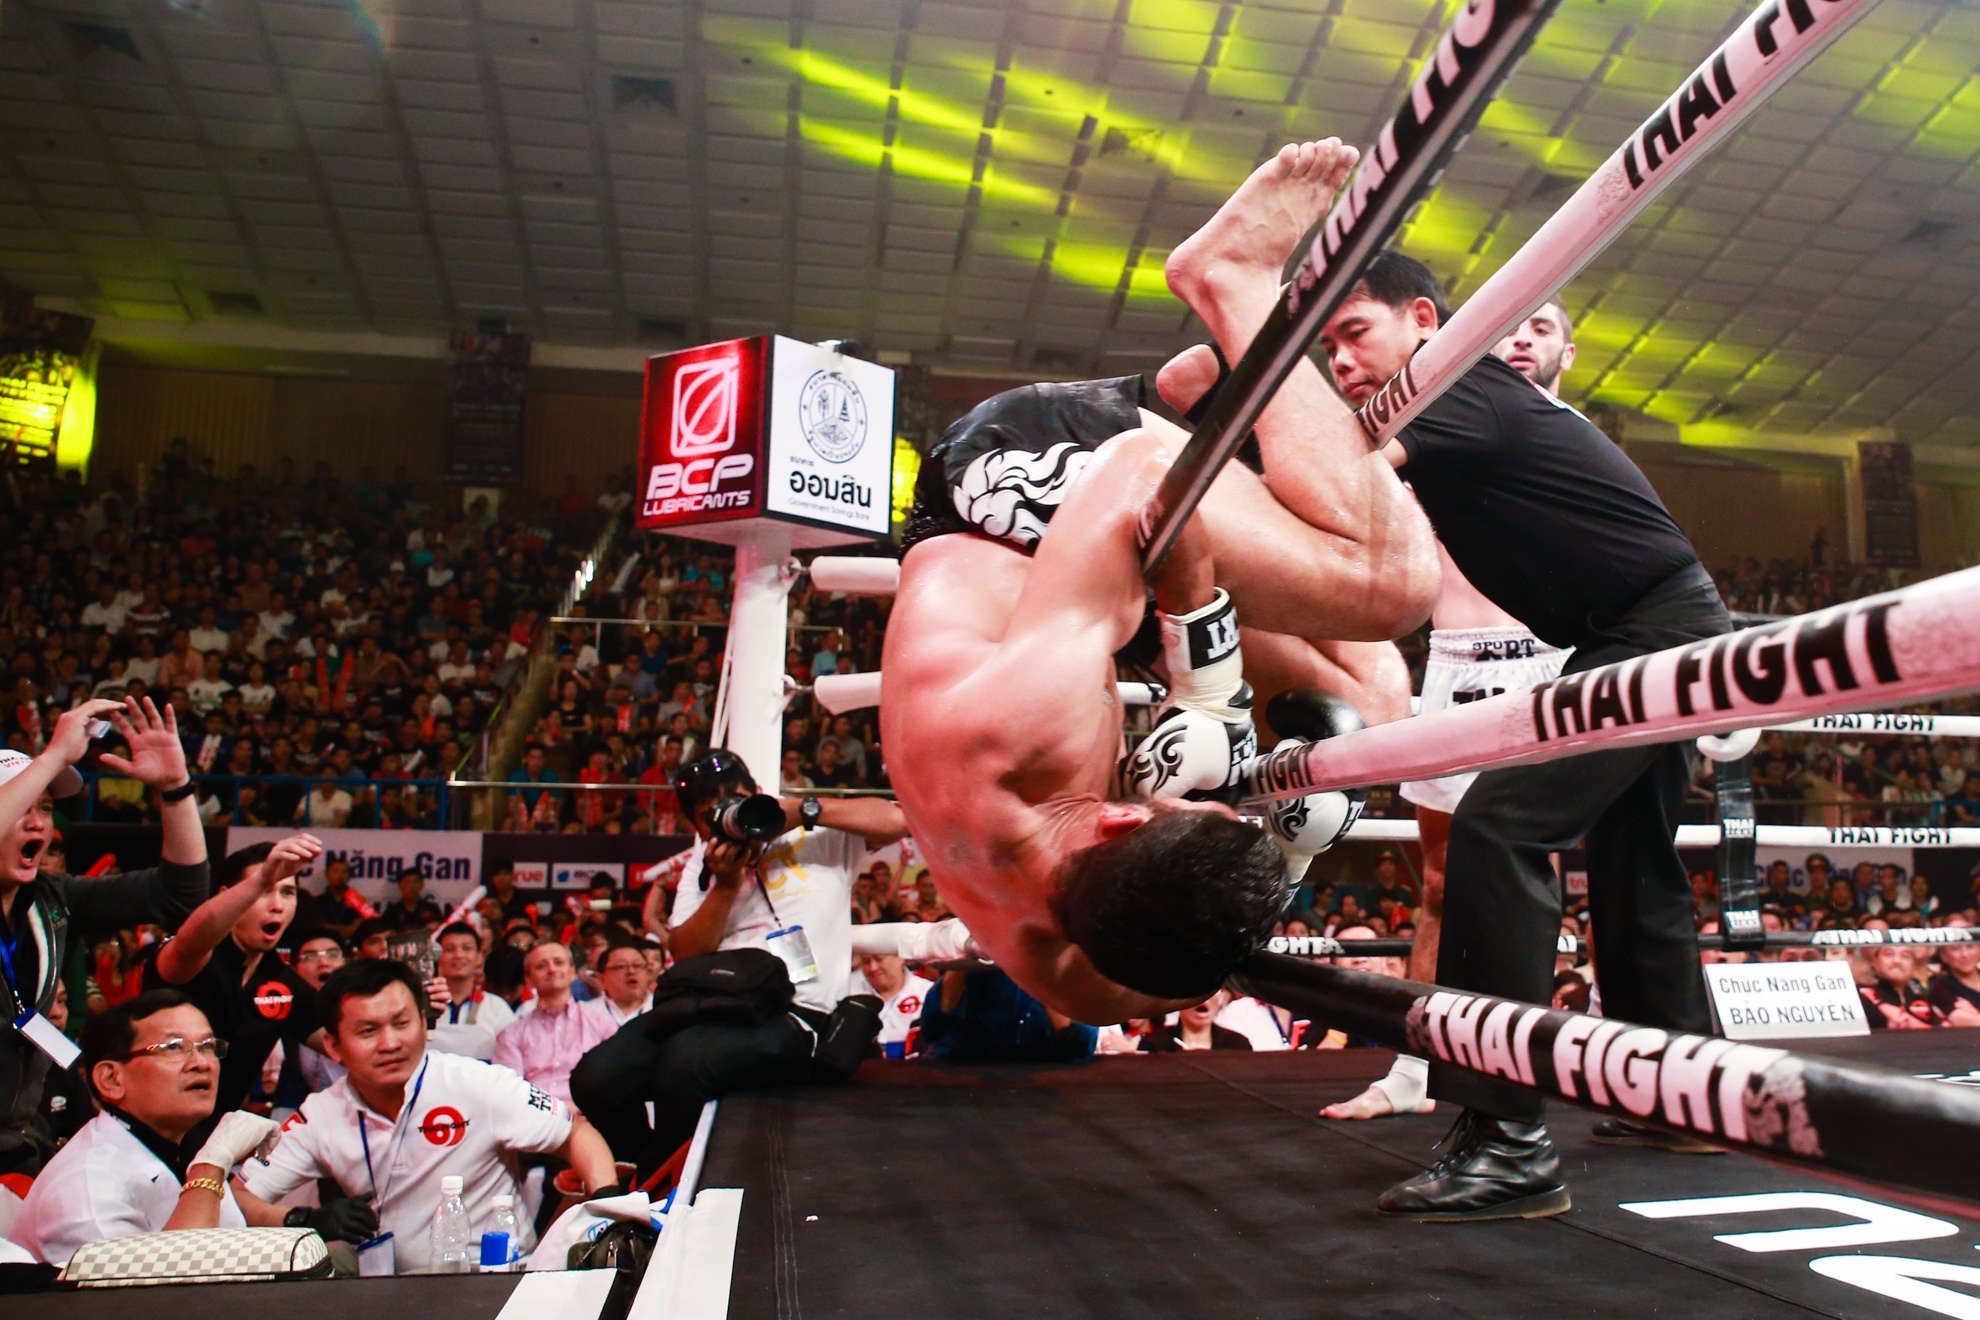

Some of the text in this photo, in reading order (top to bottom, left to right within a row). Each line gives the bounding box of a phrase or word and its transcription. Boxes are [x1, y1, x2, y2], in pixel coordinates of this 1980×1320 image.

[645, 453, 754, 500] BCP
[789, 470, 871, 508] ออมสิน
[643, 490, 752, 516] LUBRICANTS
[1531, 600, 1903, 742] THAI FIGHT
[1812, 713, 1935, 731] THAI FIGHT
[1830, 827, 1952, 844] THAI FIGHT
[416, 852, 471, 880] Gan
[513, 869, 544, 882] rue
[1815, 975, 1848, 990] Gan
[1424, 991, 1796, 1142] THAI FIGHT
